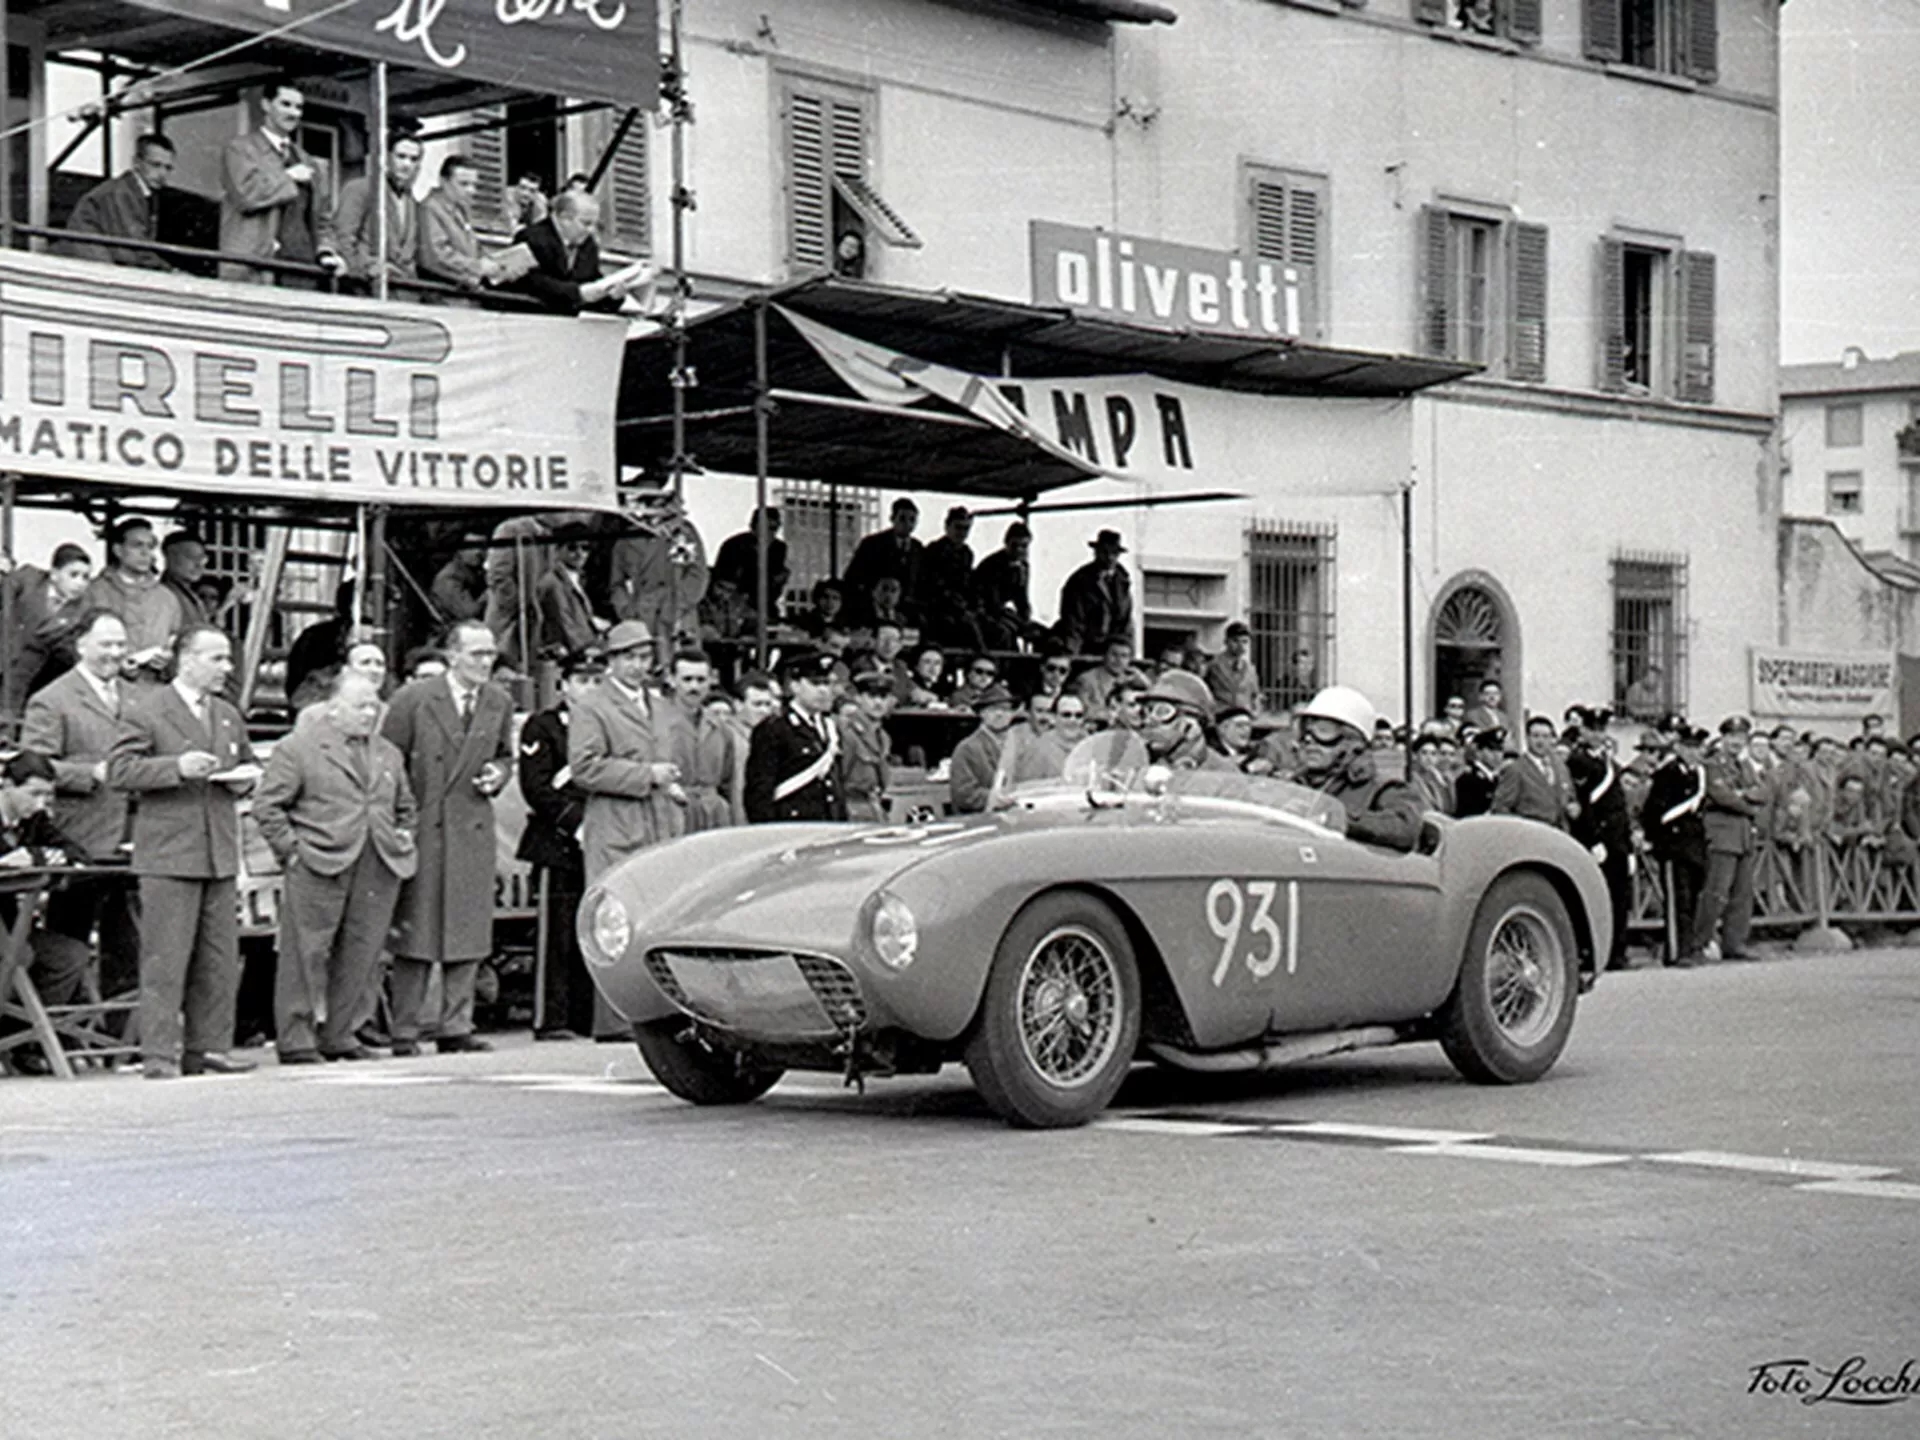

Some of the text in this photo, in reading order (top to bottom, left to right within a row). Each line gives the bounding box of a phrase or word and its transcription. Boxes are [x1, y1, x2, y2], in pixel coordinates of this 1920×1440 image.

[1057, 237, 1301, 336] olivetti
[215, 438, 352, 484] DELLE
[375, 449, 569, 490] VITTORIE
[1206, 878, 1298, 987] 931
